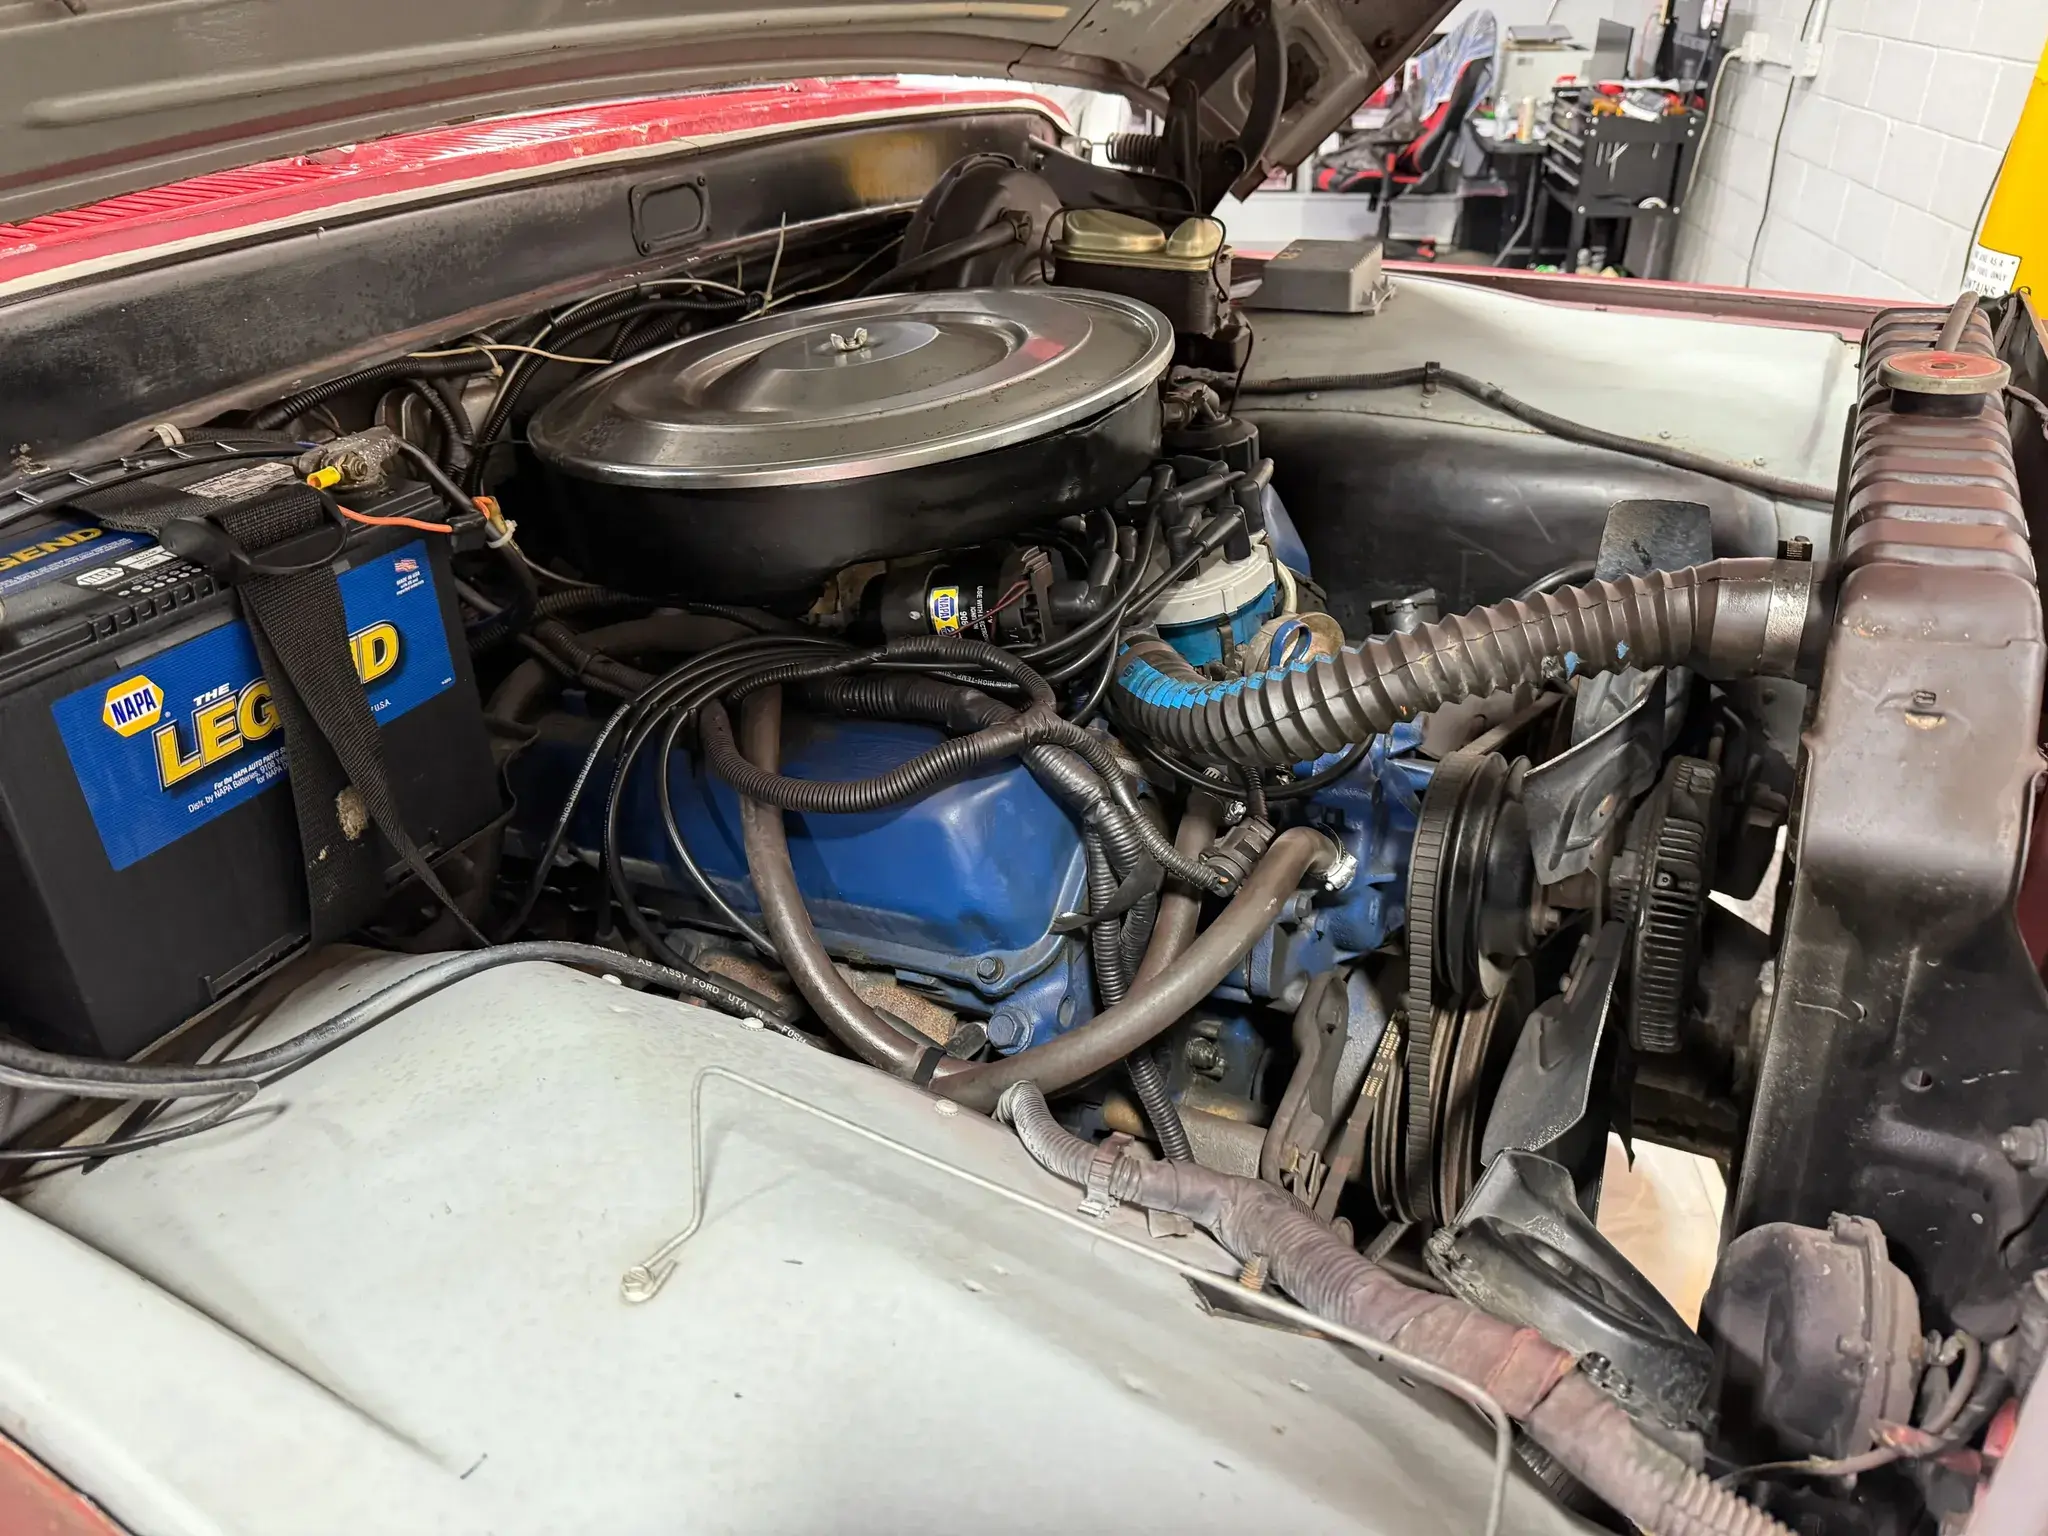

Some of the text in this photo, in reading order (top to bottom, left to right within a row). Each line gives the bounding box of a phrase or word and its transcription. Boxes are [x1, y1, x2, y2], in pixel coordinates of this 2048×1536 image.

[939, 597, 951, 619] NAPA
[111, 688, 157, 726] NAPA
[193, 682, 230, 707] THE
[205, 794, 214, 804] by
[214, 783, 233, 799] NAPA
[260, 759, 275, 774] 9108
[214, 781, 223, 790] For
[224, 776, 233, 785] the
[232, 766, 248, 780] NAPA
[248, 759, 263, 772] AUTO
[263, 749, 280, 764] PARTS
[256, 766, 282, 784] for NAPA
[661, 965, 688, 981] ASSY
[692, 977, 720, 994] FORD
[728, 993, 748, 1010] UTA
[755, 1009, 765, 1019] N
